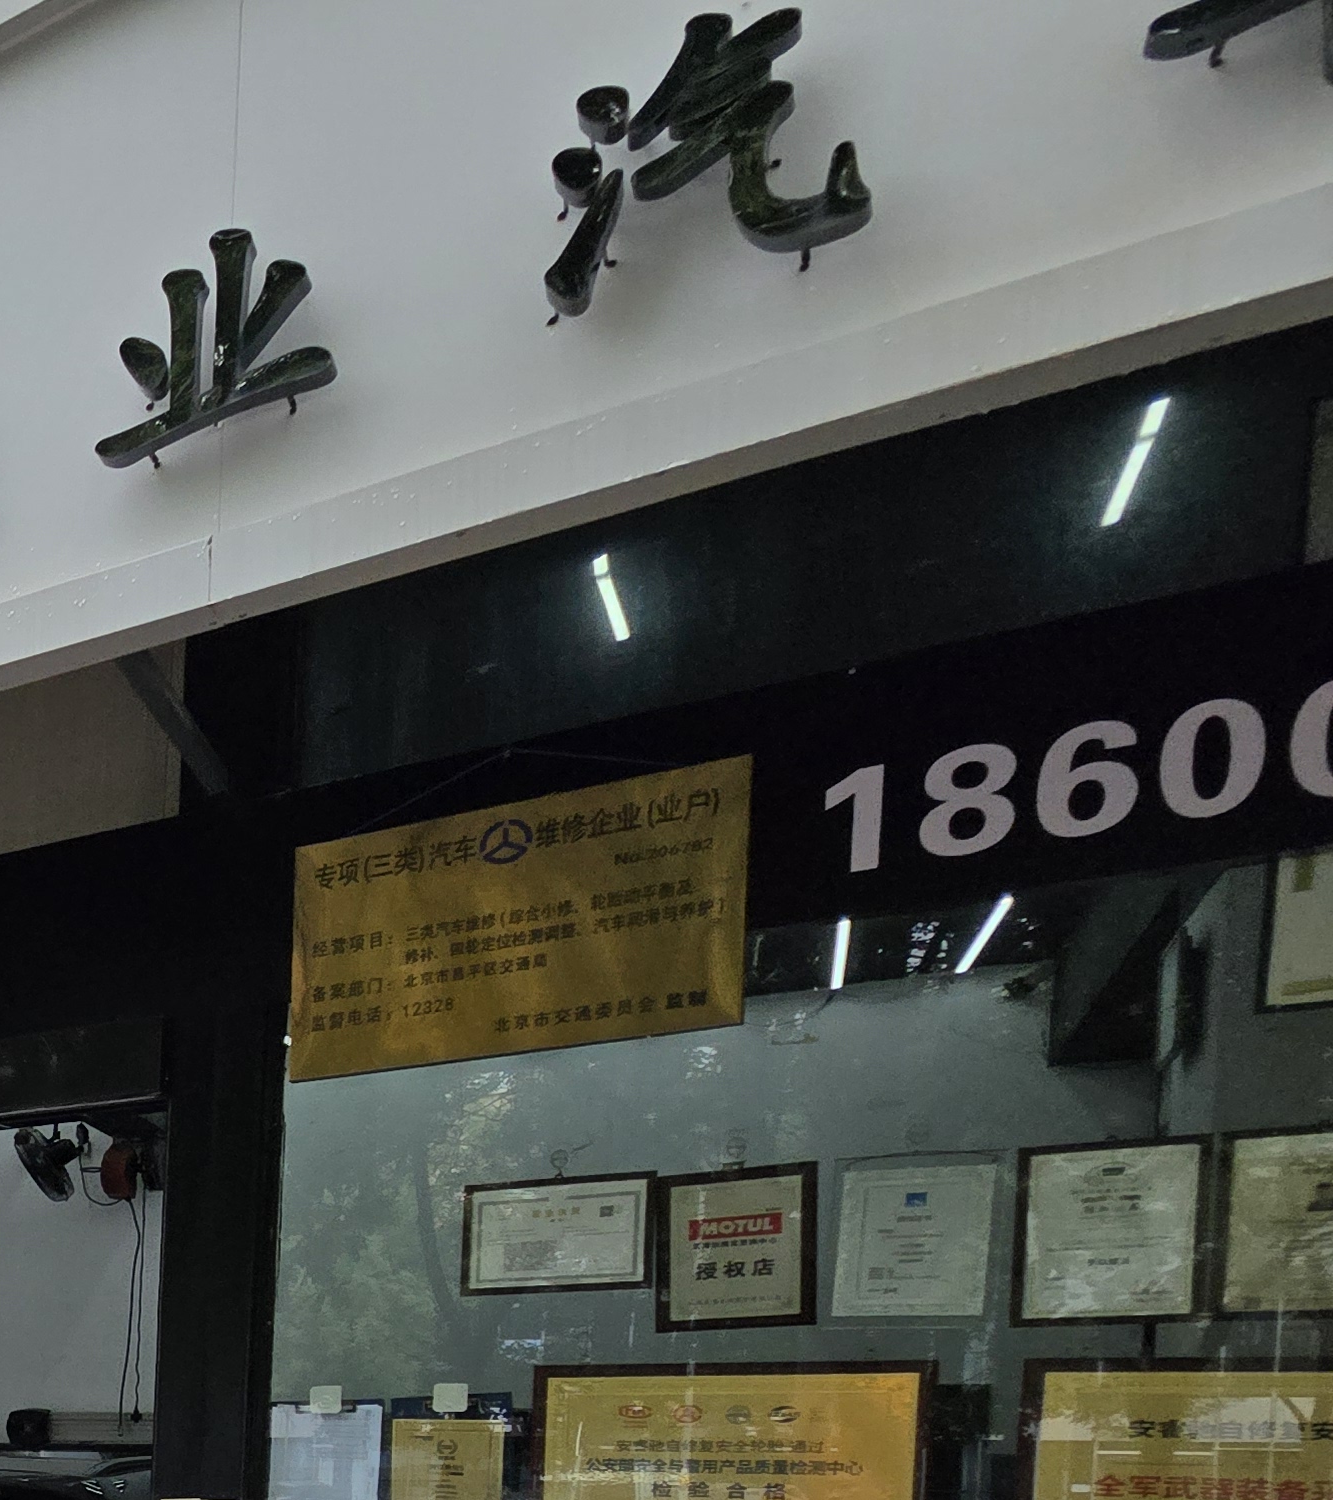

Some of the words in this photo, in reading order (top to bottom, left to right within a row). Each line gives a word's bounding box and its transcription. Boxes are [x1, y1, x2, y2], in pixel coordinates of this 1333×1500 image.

[402, 998, 454, 1019] 12328
[699, 1217, 774, 1236] MOTUL
[695, 1258, 776, 1282] 授权店
